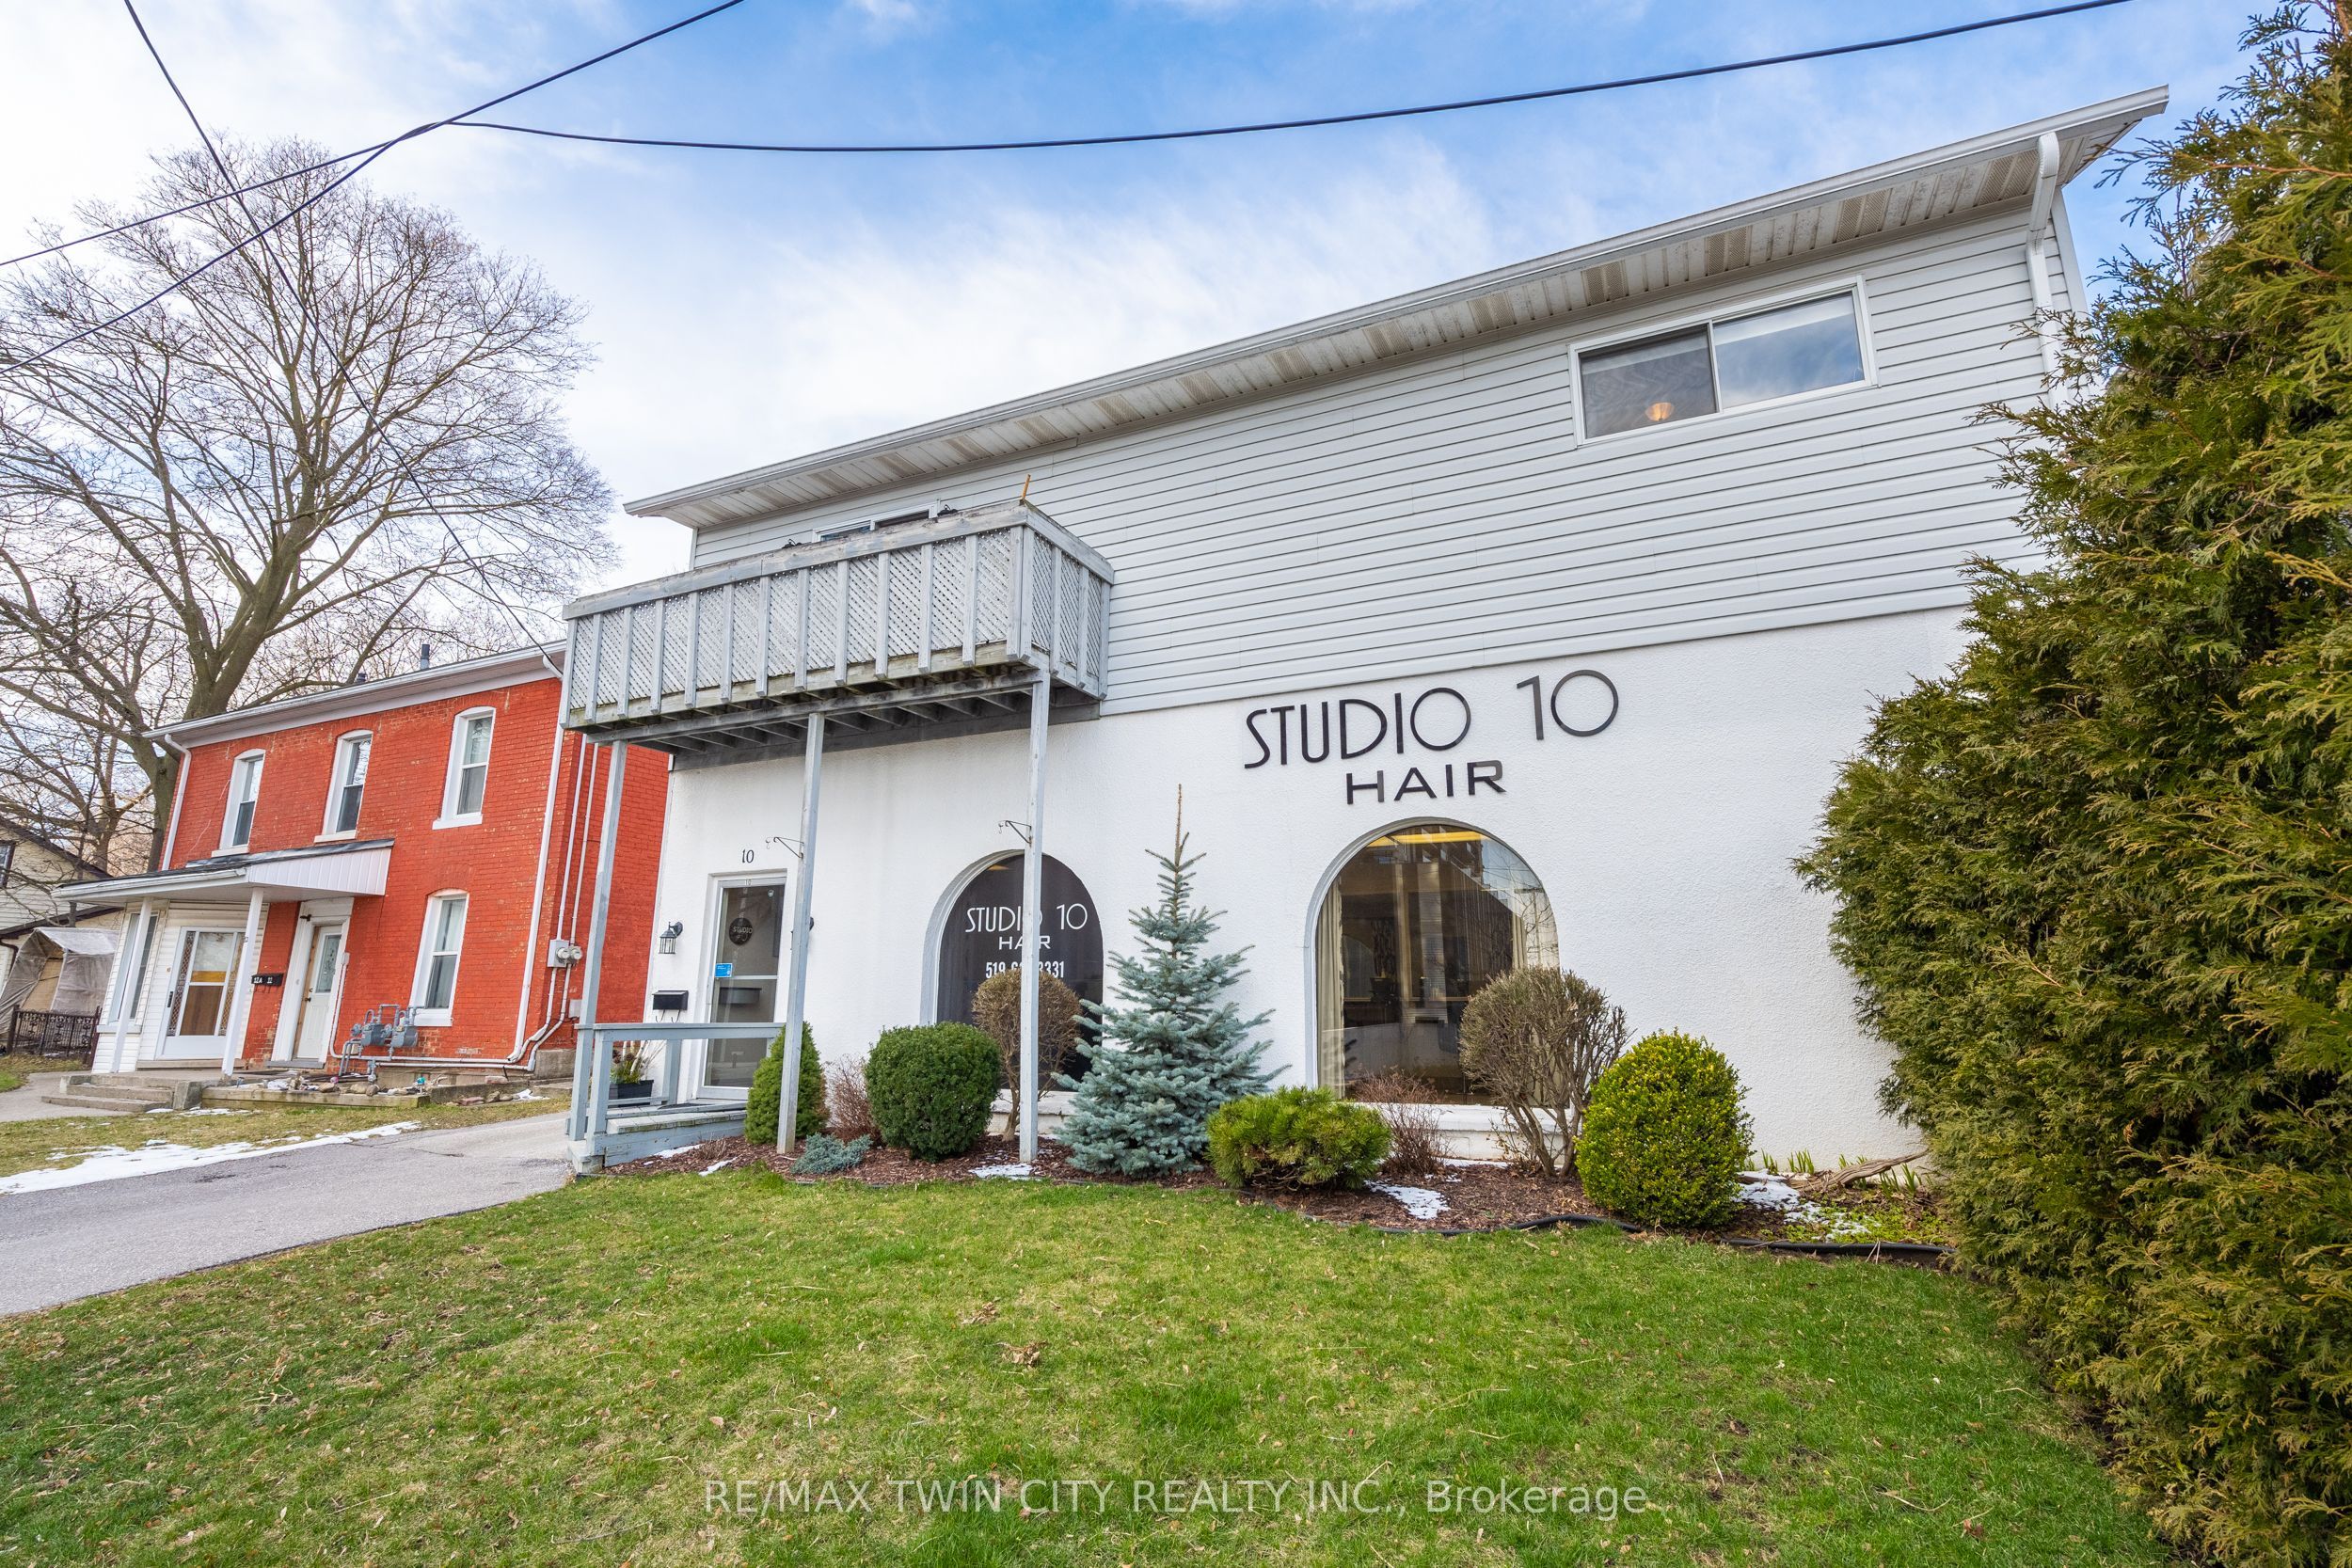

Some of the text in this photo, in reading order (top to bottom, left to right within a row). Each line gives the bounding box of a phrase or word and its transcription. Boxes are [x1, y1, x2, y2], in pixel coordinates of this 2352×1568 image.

[1244, 669, 1619, 769] STUDIO 10
[1345, 759, 1507, 805] HAIR
[741, 849, 755, 863] 10
[965, 903, 1088, 932] STUDI 10
[998, 935, 1051, 950] HAR
